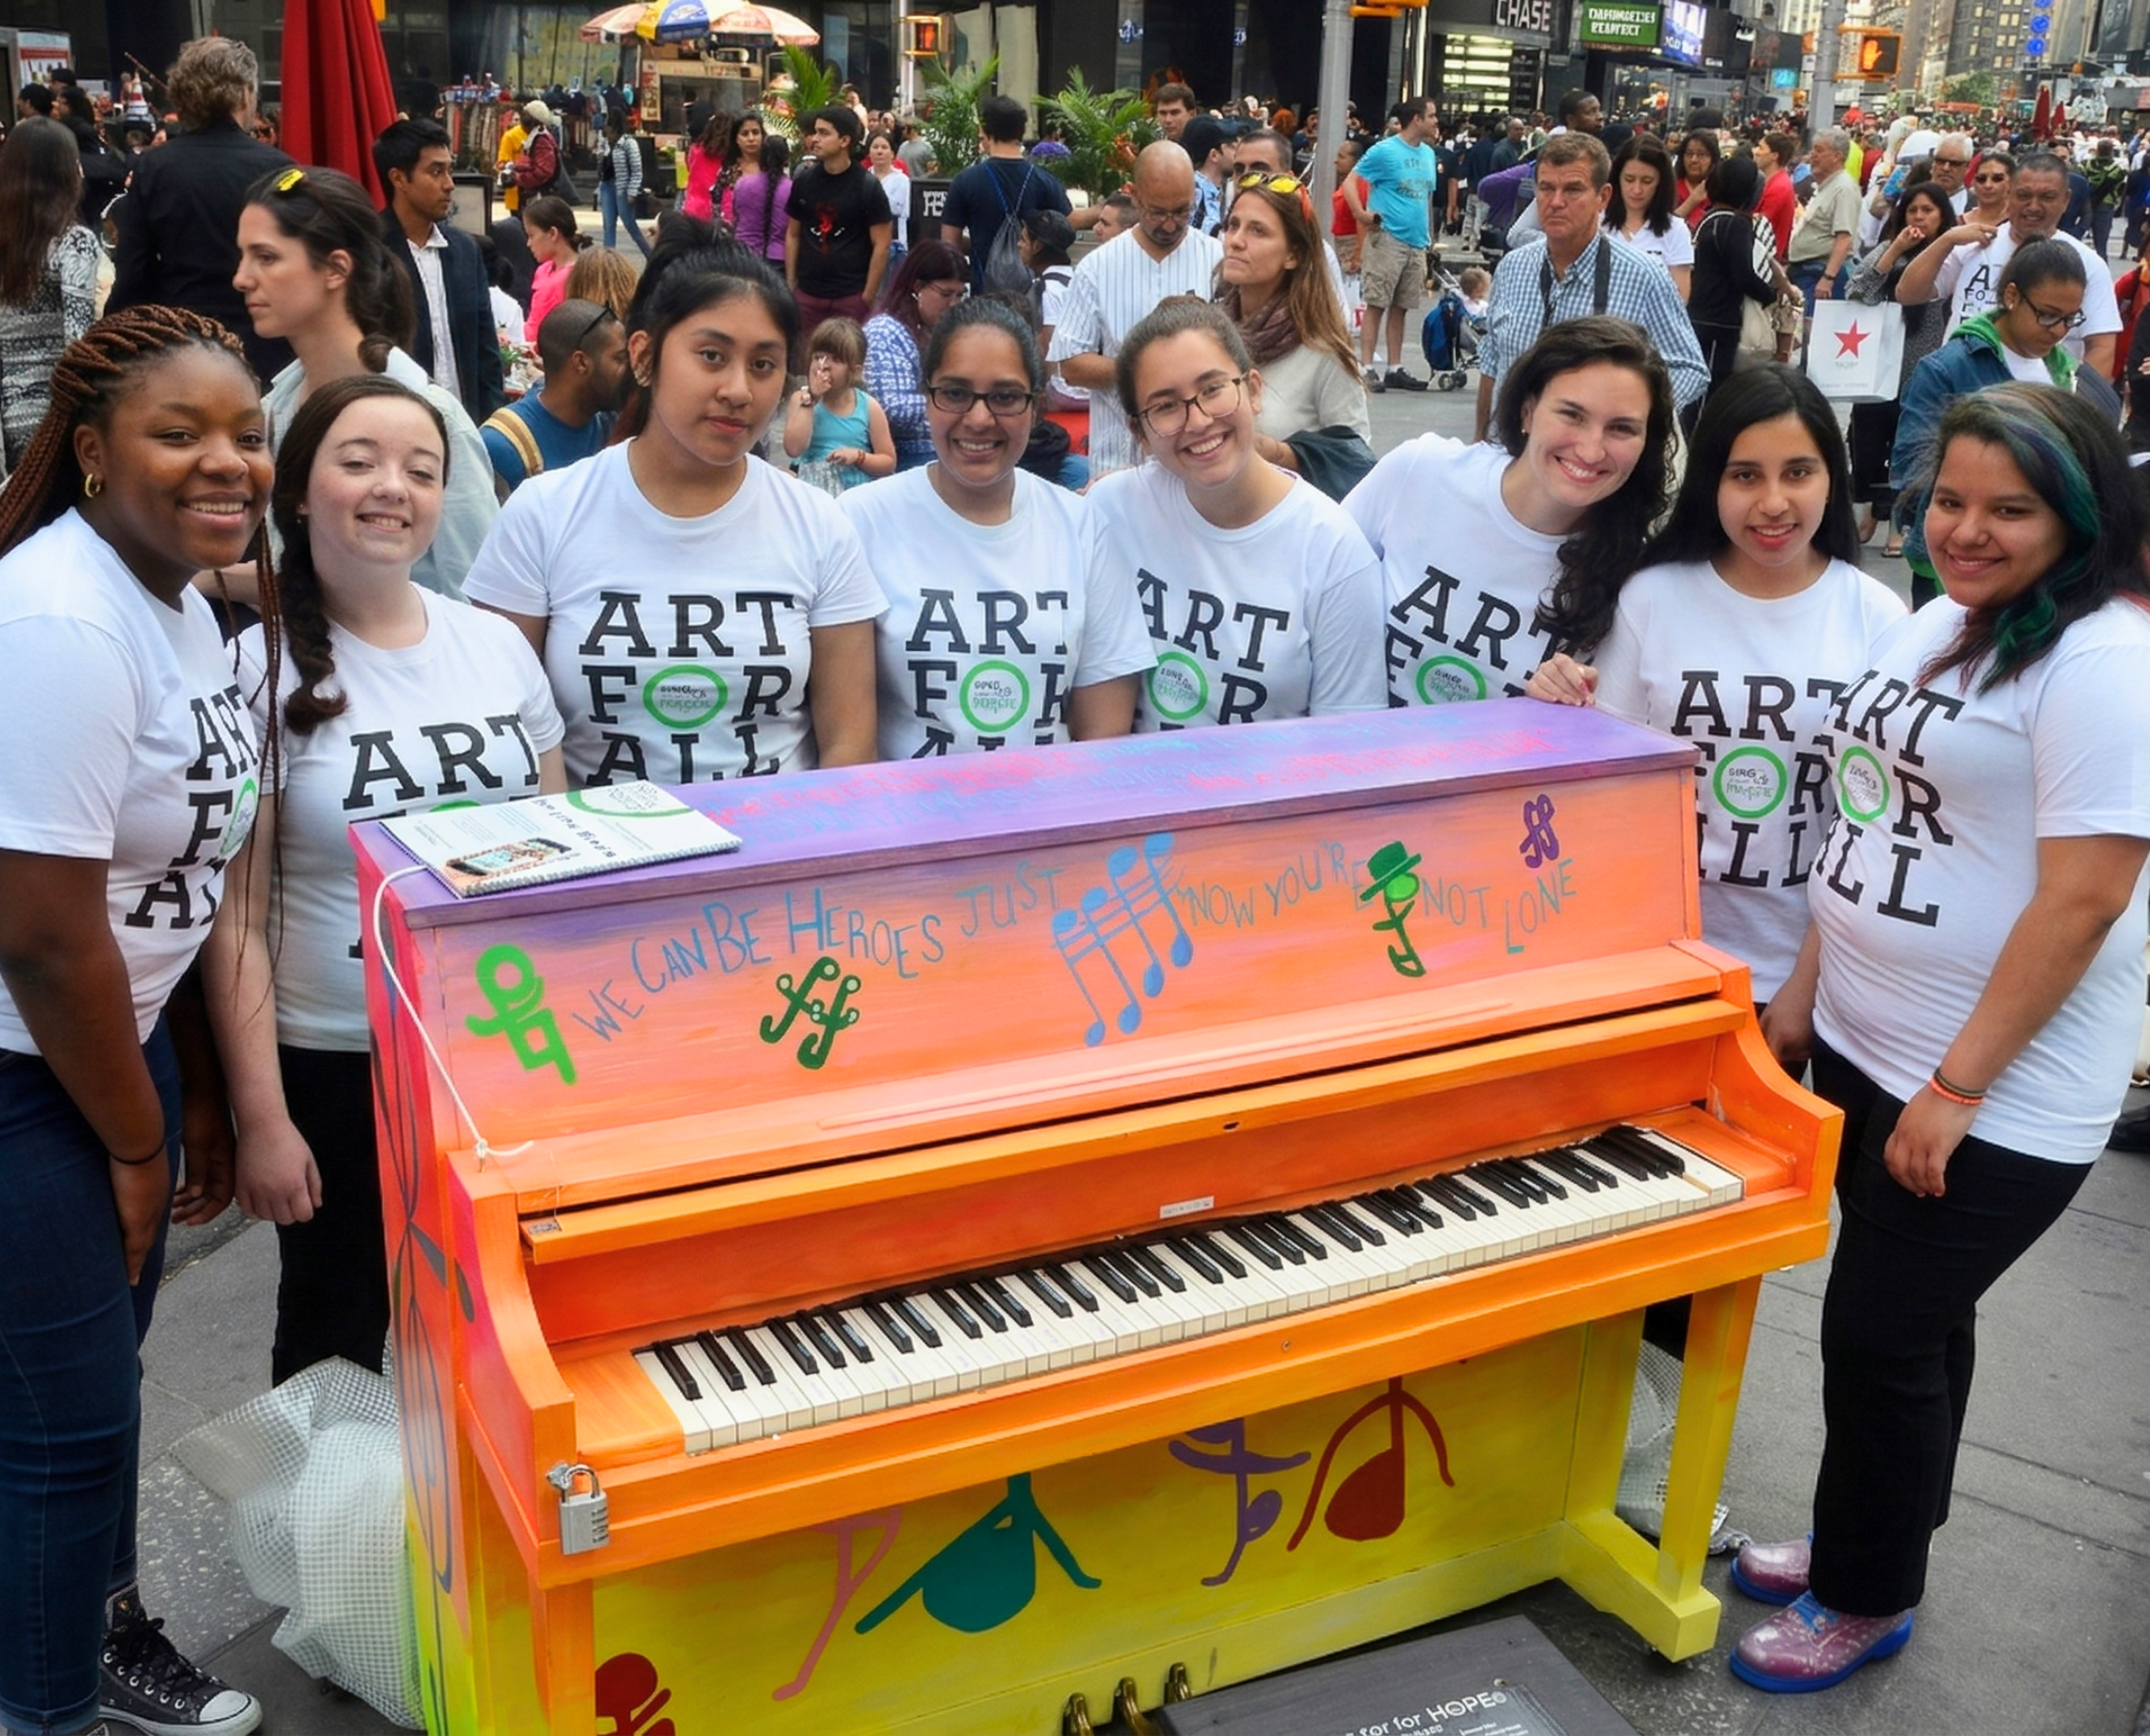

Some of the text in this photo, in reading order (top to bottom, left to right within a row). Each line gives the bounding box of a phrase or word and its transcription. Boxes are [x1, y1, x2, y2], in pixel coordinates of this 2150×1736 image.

[1497, 0, 1550, 32] CHASE
[578, 590, 795, 658] ART
[1137, 567, 1290, 673] ART
[572, 978, 645, 1043] WE
[631, 926, 709, 993] CAN
[702, 901, 772, 975] BE
[784, 887, 945, 980] HEROES
[953, 860, 1065, 936] JUST
[1421, 876, 1491, 929] NOT
[1392, 1714, 1423, 1731] for
